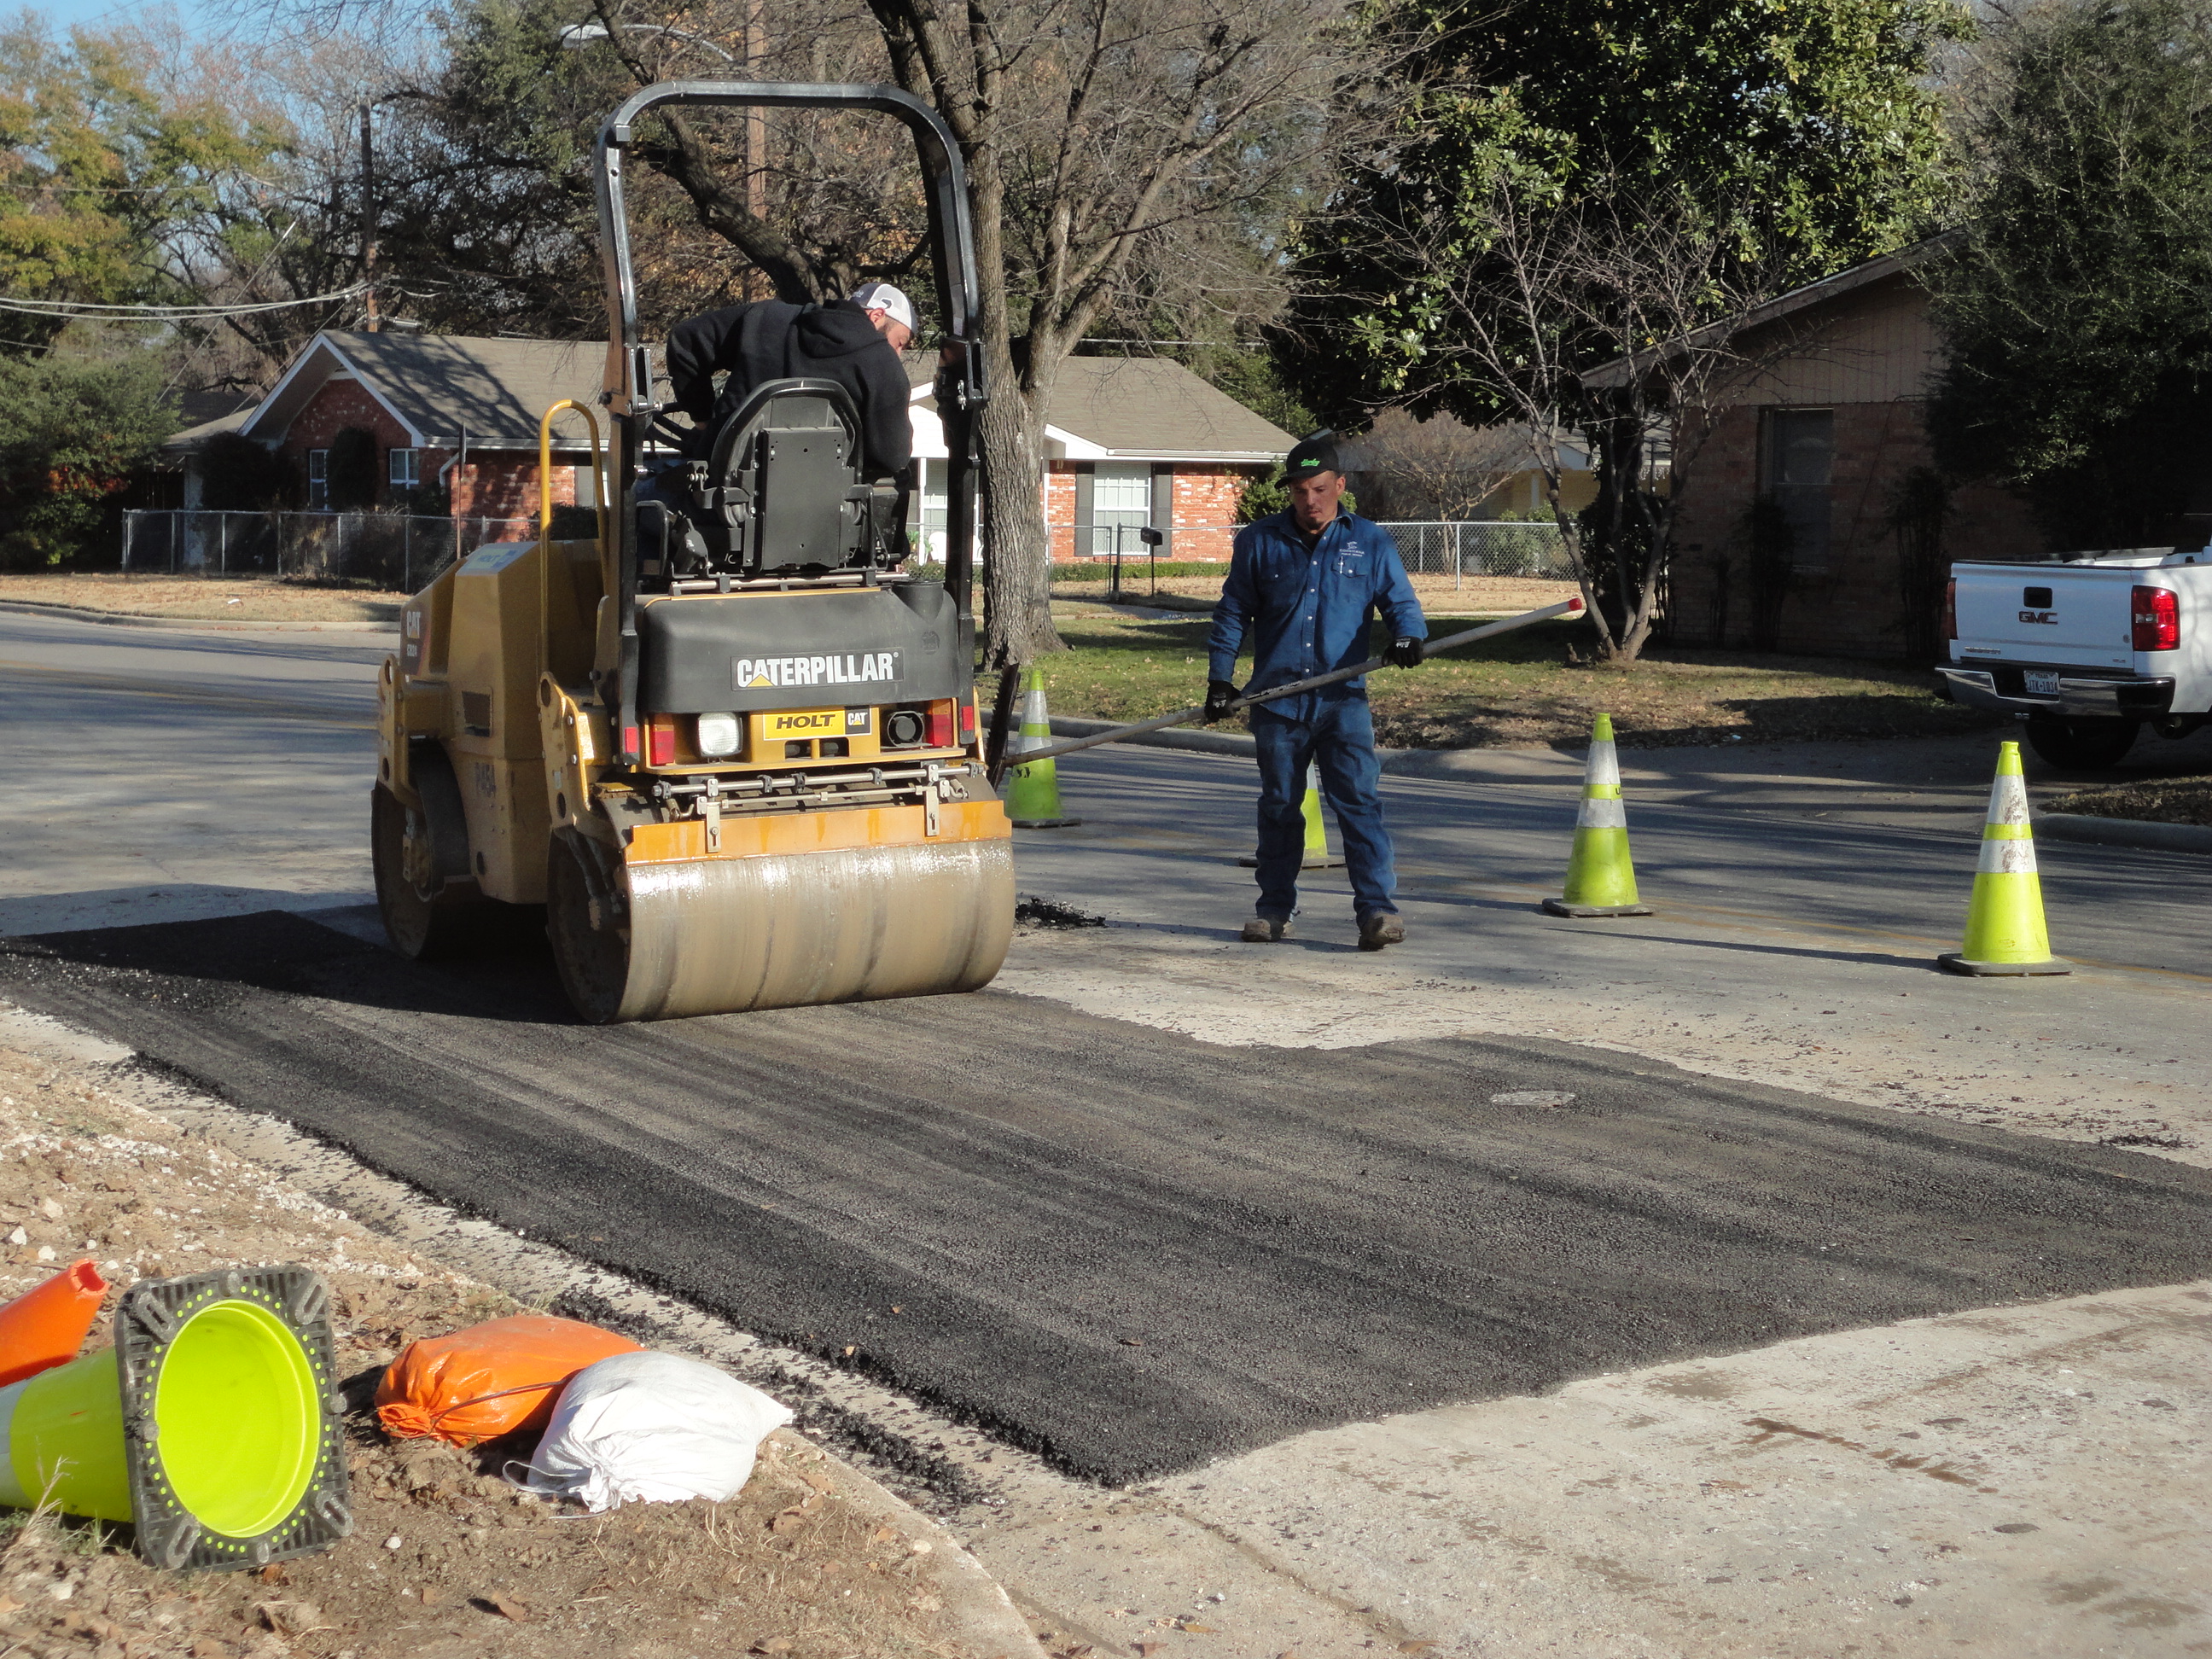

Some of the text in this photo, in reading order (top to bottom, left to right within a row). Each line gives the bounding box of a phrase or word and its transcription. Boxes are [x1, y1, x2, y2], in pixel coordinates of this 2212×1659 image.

[406, 610, 421, 639] CAT
[2018, 610, 2058, 625] GMC
[737, 653, 894, 687] CATERPILLAR
[776, 713, 836, 730] HOLT
[847, 712, 868, 725] CAT
